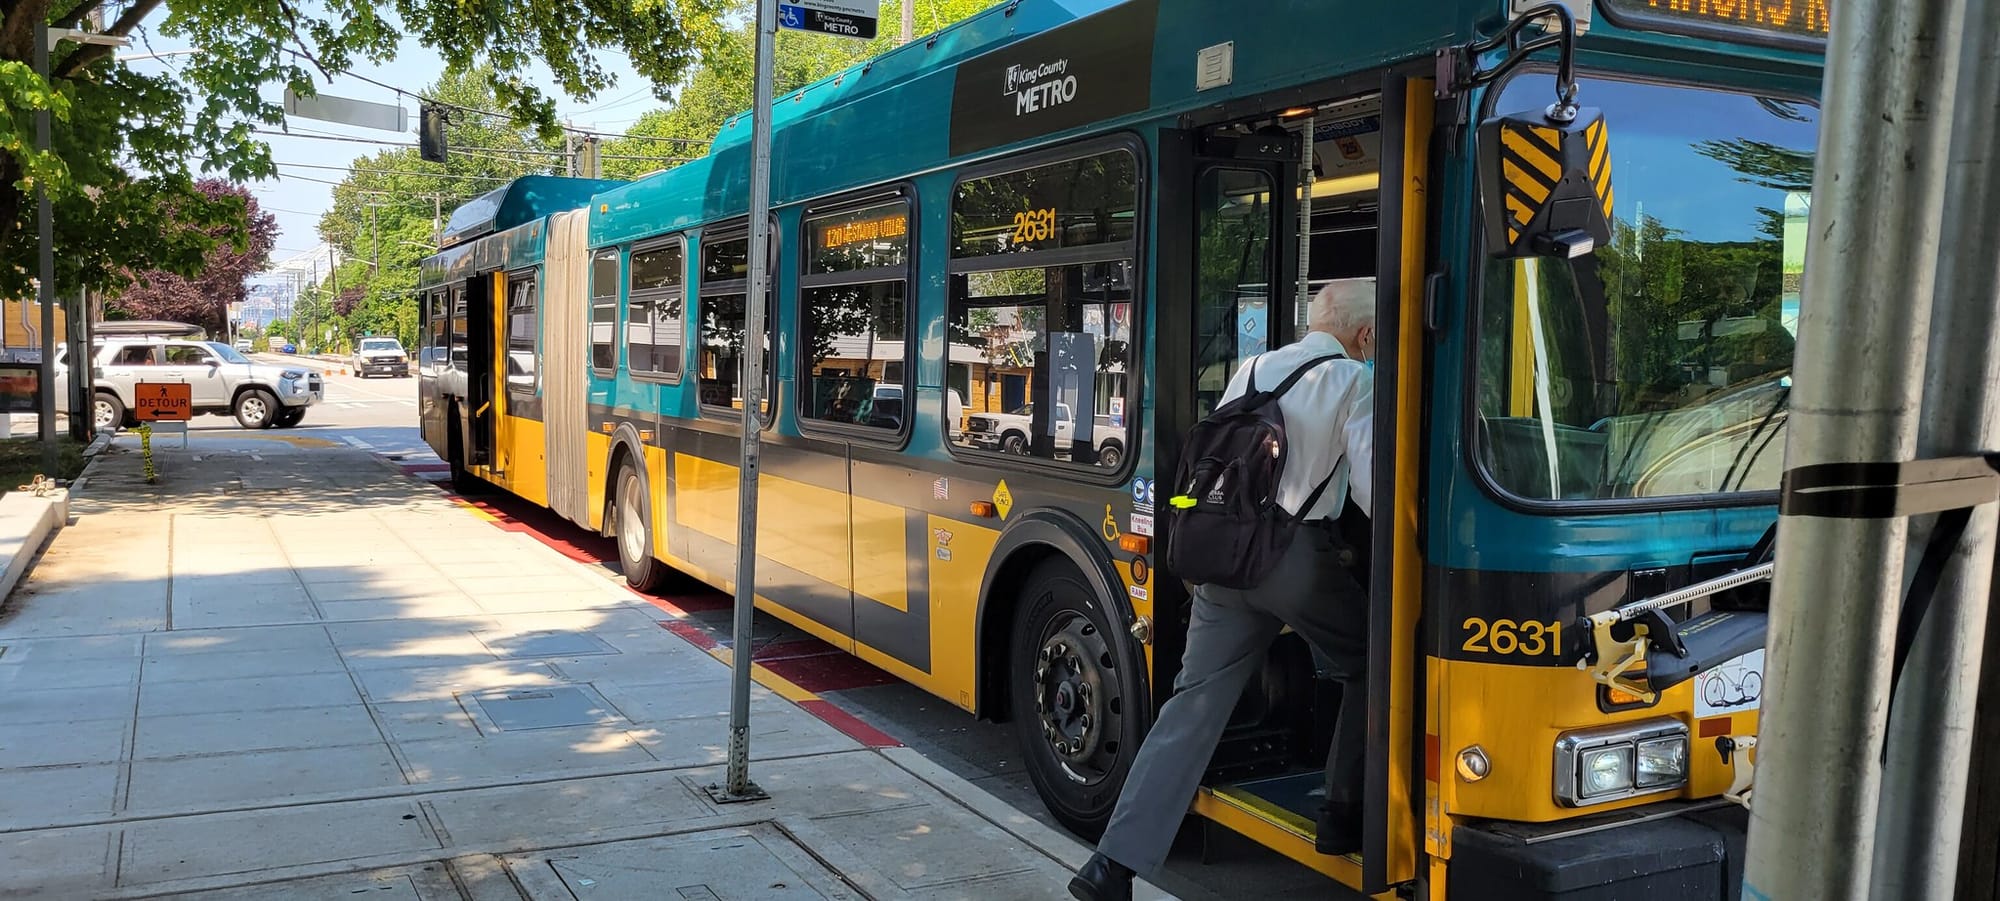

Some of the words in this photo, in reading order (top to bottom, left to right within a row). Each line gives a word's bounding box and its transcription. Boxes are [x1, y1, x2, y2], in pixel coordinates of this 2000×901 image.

[824, 22, 859, 35] METRO
[836, 16, 853, 25] County
[1018, 69, 1038, 84] King
[1038, 58, 1069, 78] County
[1016, 75, 1078, 117] METRO
[1013, 207, 1056, 243] 2631
[826, 228, 842, 248] 120
[140, 398, 187, 408] DETOUR
[1131, 587, 1147, 598] RAMP
[1462, 617, 1562, 656] 2631
